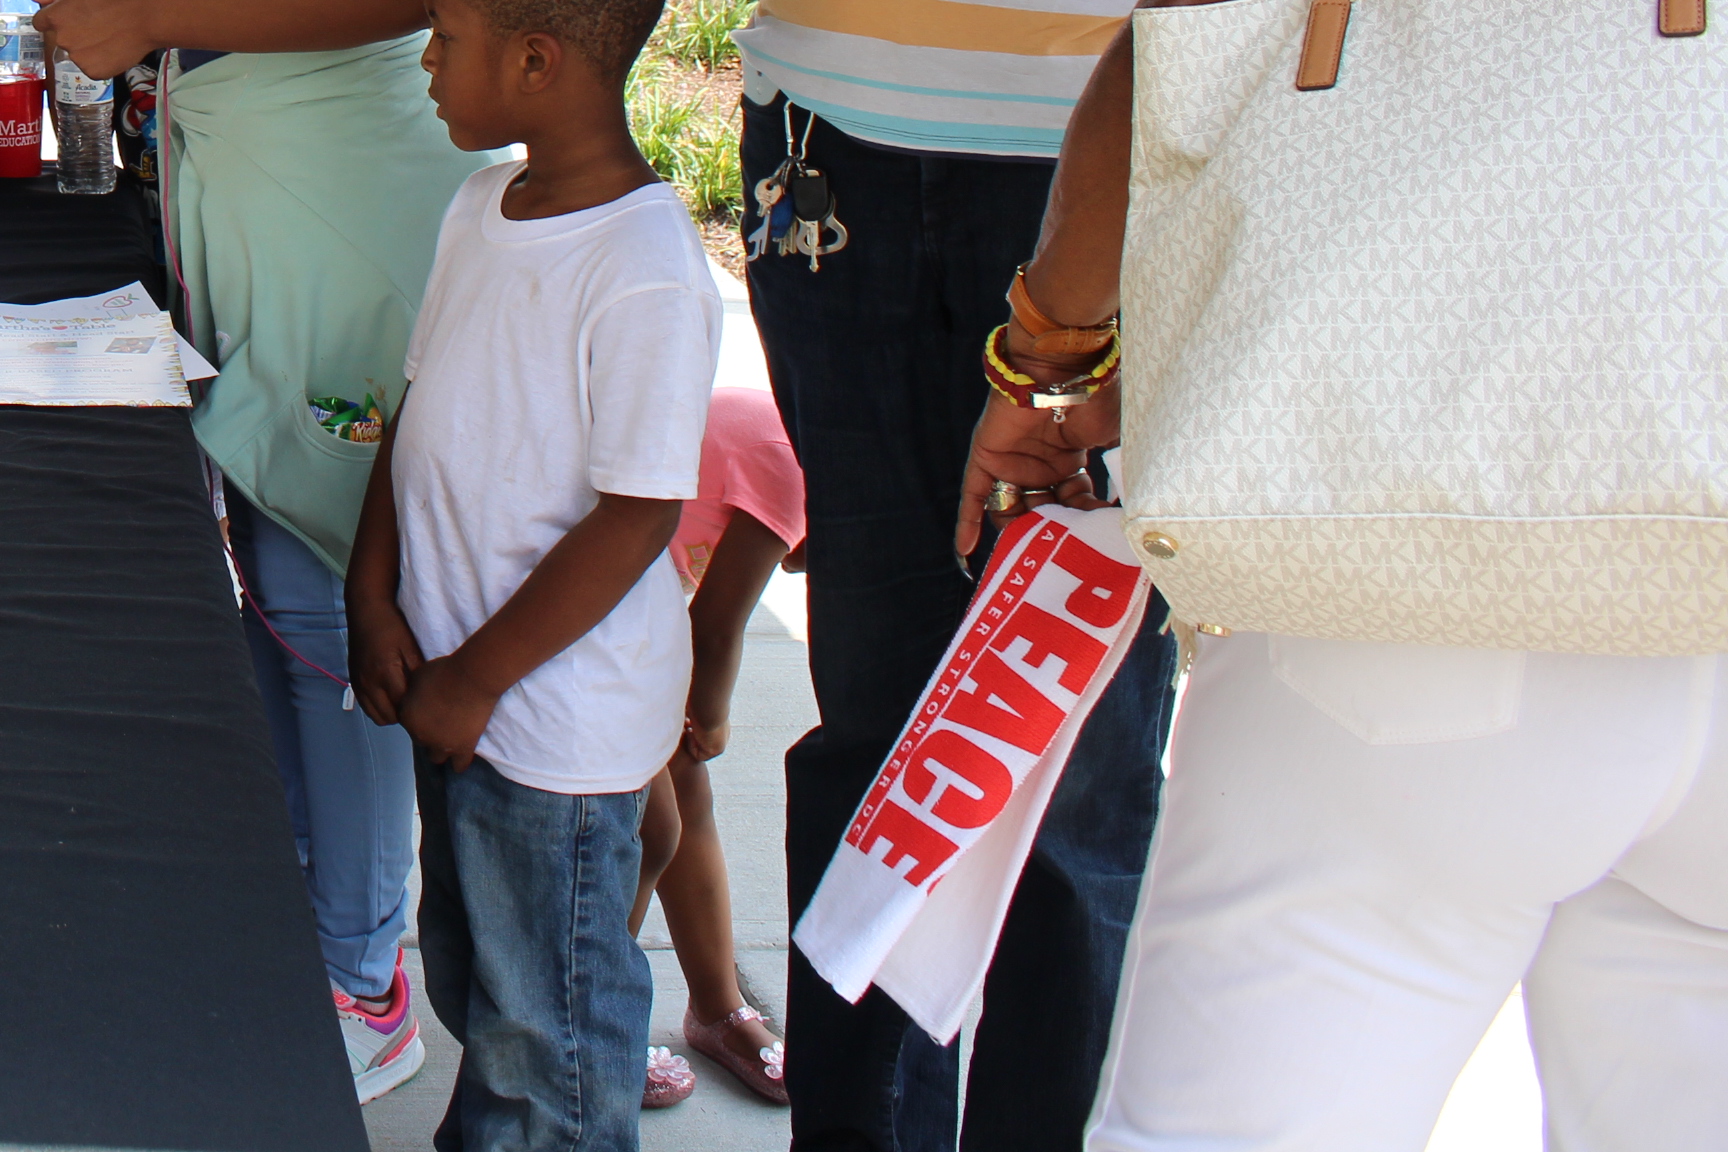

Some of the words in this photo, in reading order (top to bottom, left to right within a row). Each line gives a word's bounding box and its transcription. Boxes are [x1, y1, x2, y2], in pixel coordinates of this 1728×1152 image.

[1040, 528, 1056, 542] A
[974, 554, 1038, 637] SAFER
[858, 532, 1142, 887] PEACE
[876, 647, 972, 790] STRONGER
[850, 804, 875, 838] DC
